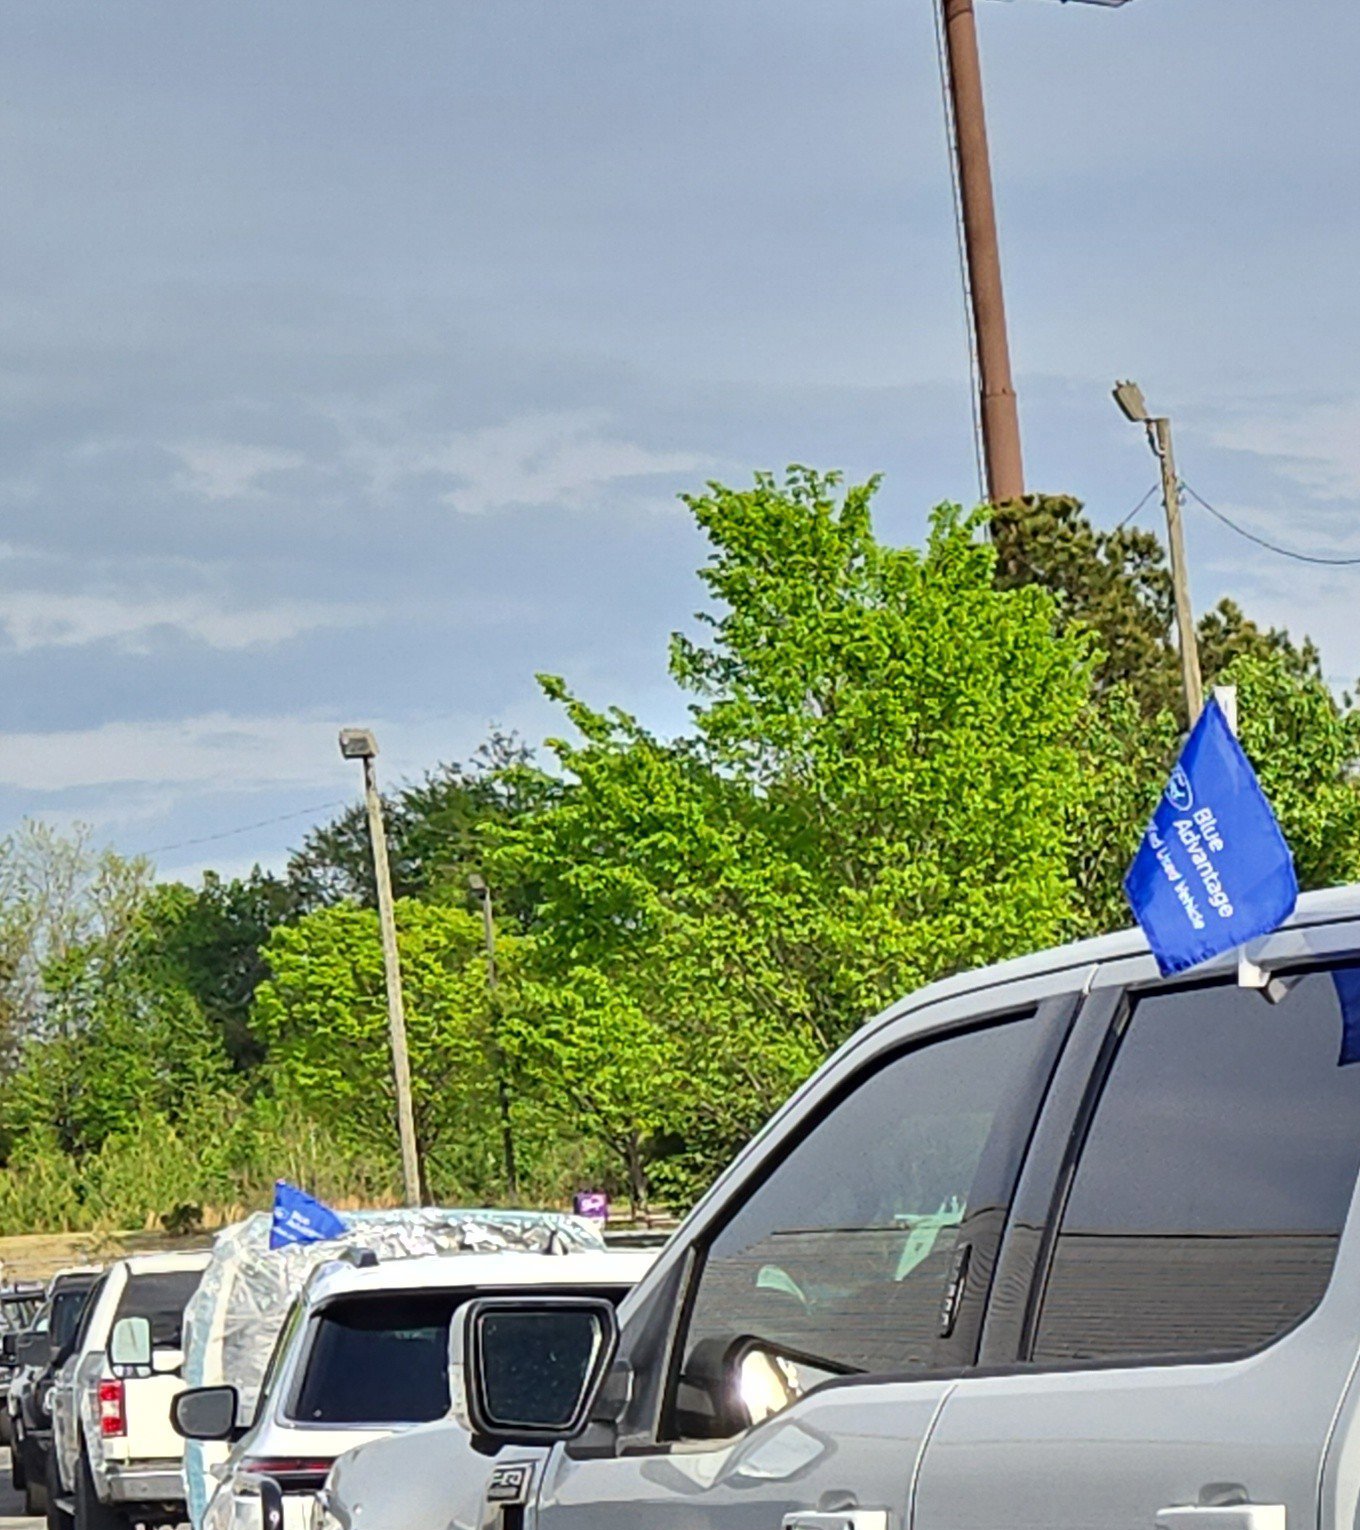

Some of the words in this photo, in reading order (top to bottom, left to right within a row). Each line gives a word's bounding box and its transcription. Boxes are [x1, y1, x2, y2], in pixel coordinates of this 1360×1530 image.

[1193, 807, 1224, 853] Blue
[1173, 819, 1234, 918] Advantage
[1174, 878, 1206, 930] Vehicle
